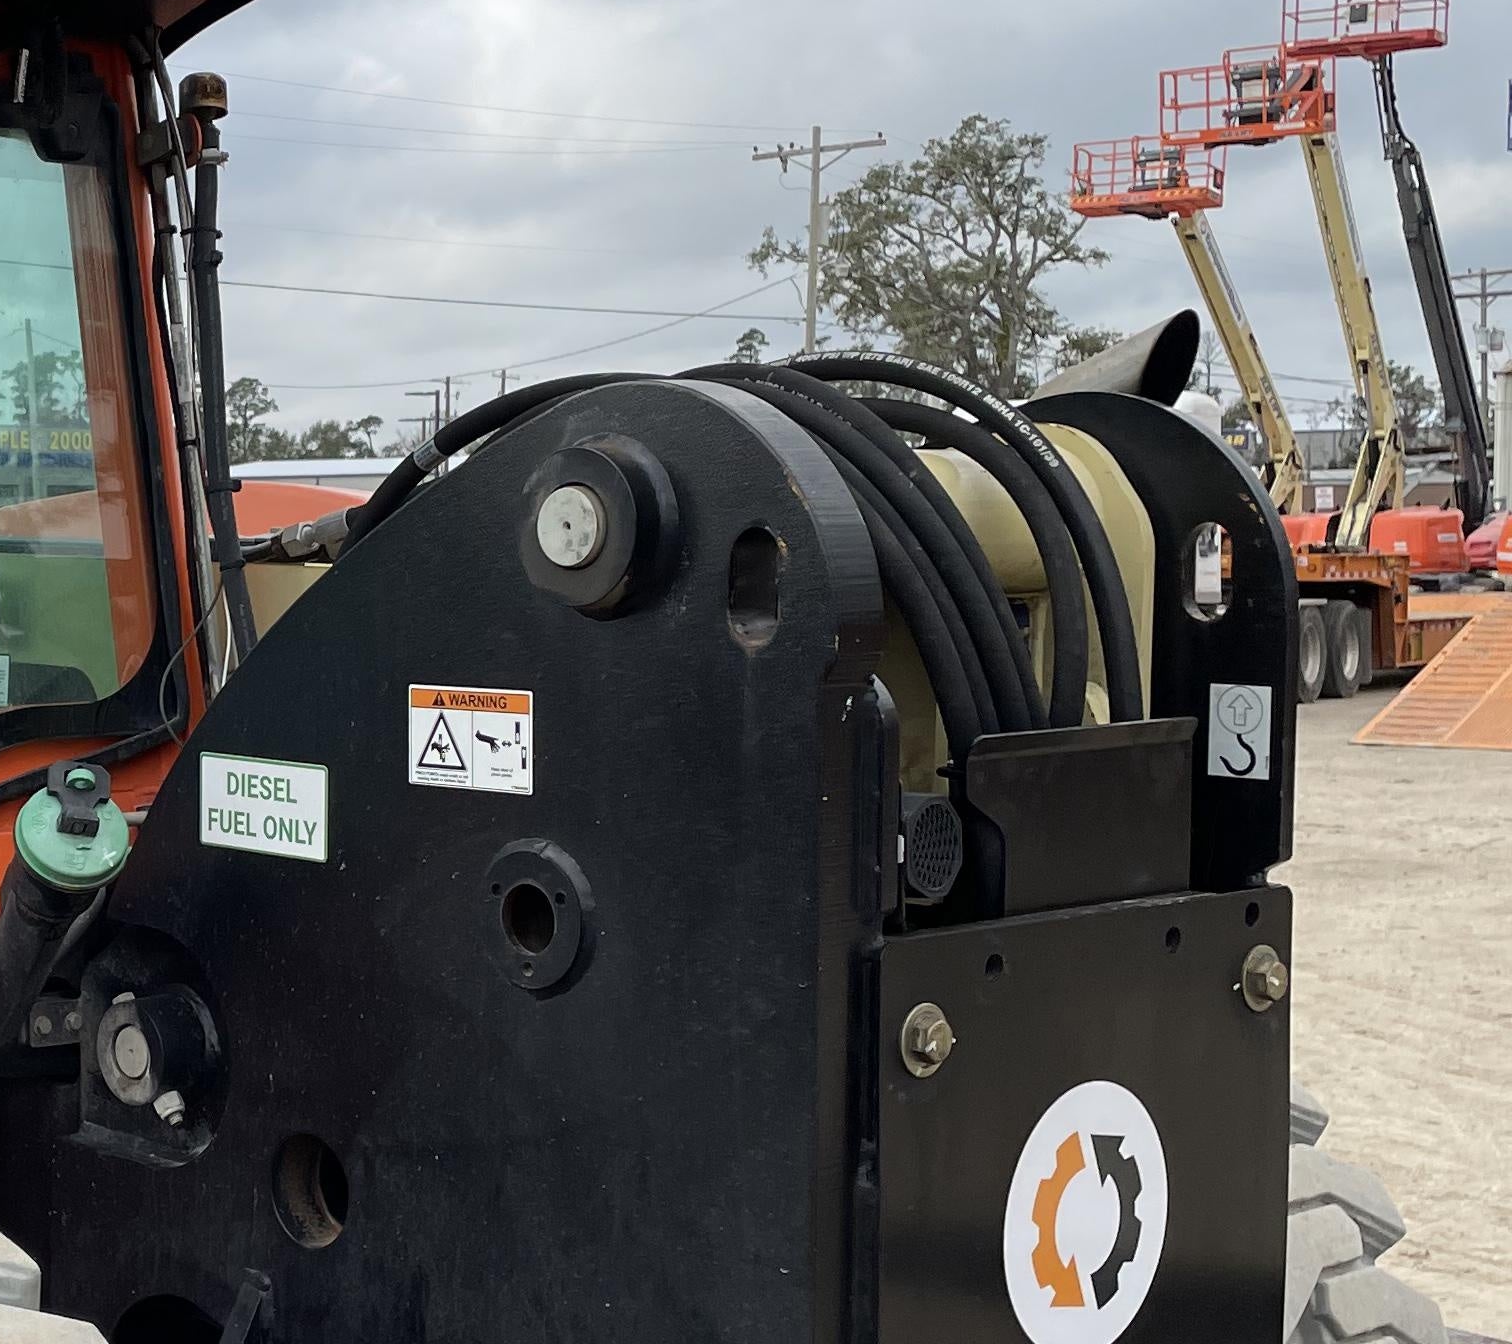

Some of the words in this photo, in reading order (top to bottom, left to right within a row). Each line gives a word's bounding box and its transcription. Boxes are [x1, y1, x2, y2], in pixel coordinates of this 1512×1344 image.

[916, 361, 943, 376] SAE
[982, 394, 1016, 421] MSHA
[0, 430, 41, 449] PLE
[50, 431, 92, 450] 2000
[448, 693, 508, 710] WARNING
[226, 771, 298, 804] DIESEL
[207, 807, 257, 838] FUEL
[263, 815, 318, 846] ONLY
